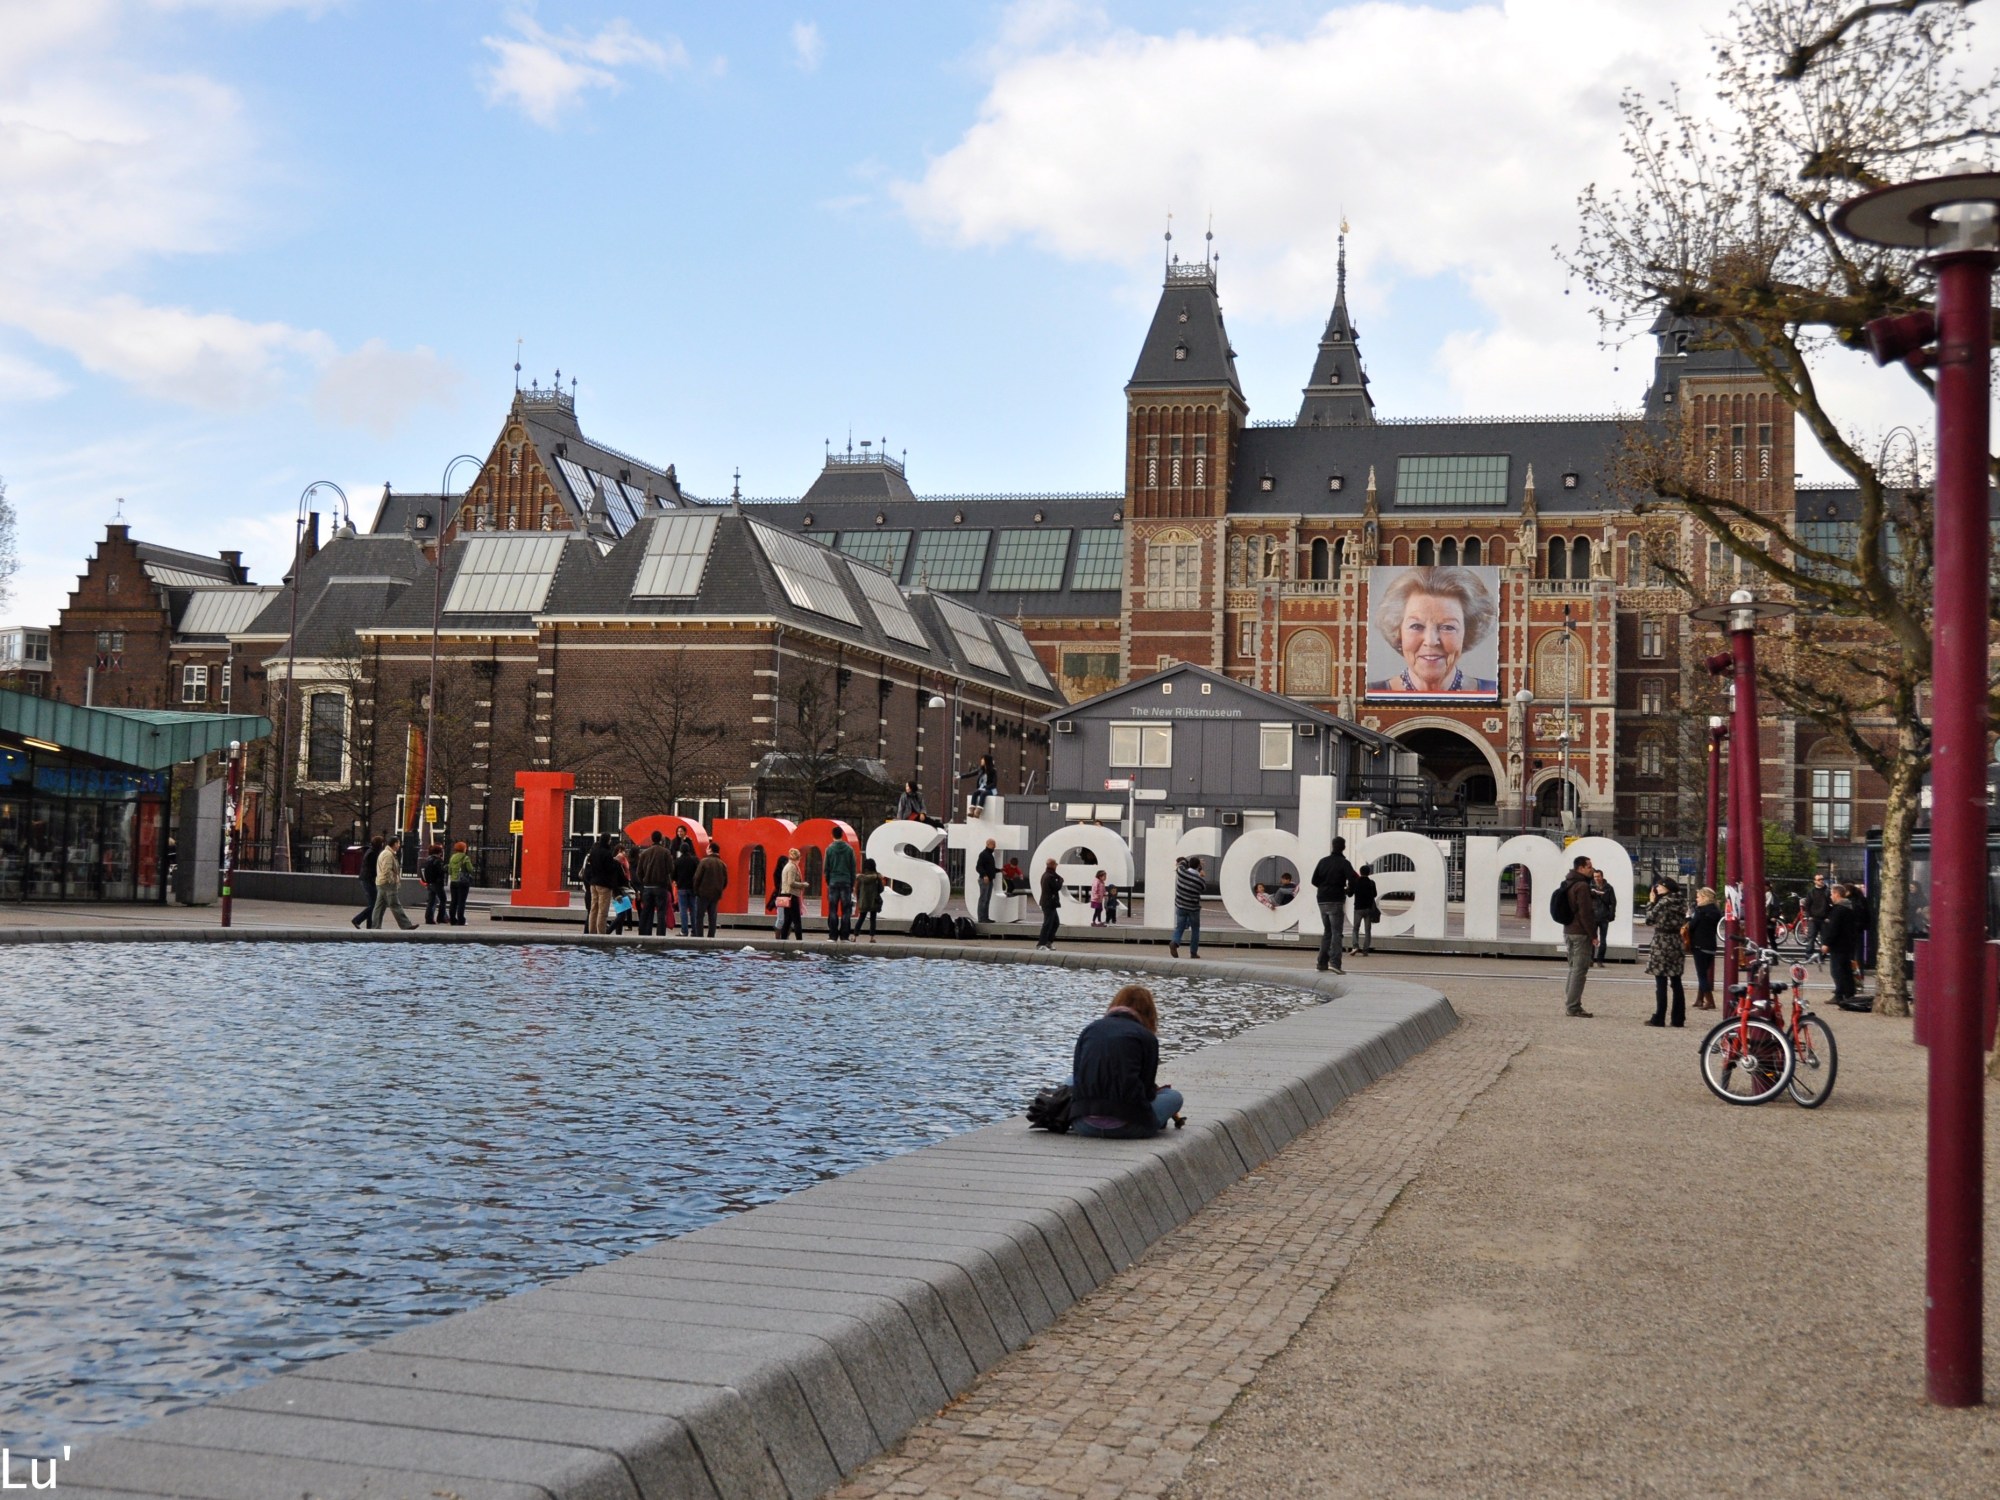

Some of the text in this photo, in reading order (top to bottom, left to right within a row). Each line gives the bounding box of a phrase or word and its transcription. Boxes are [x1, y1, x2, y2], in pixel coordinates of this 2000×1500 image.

[1130, 706, 1242, 718] The New Rijksmuseum
[511, 771, 575, 908] I
